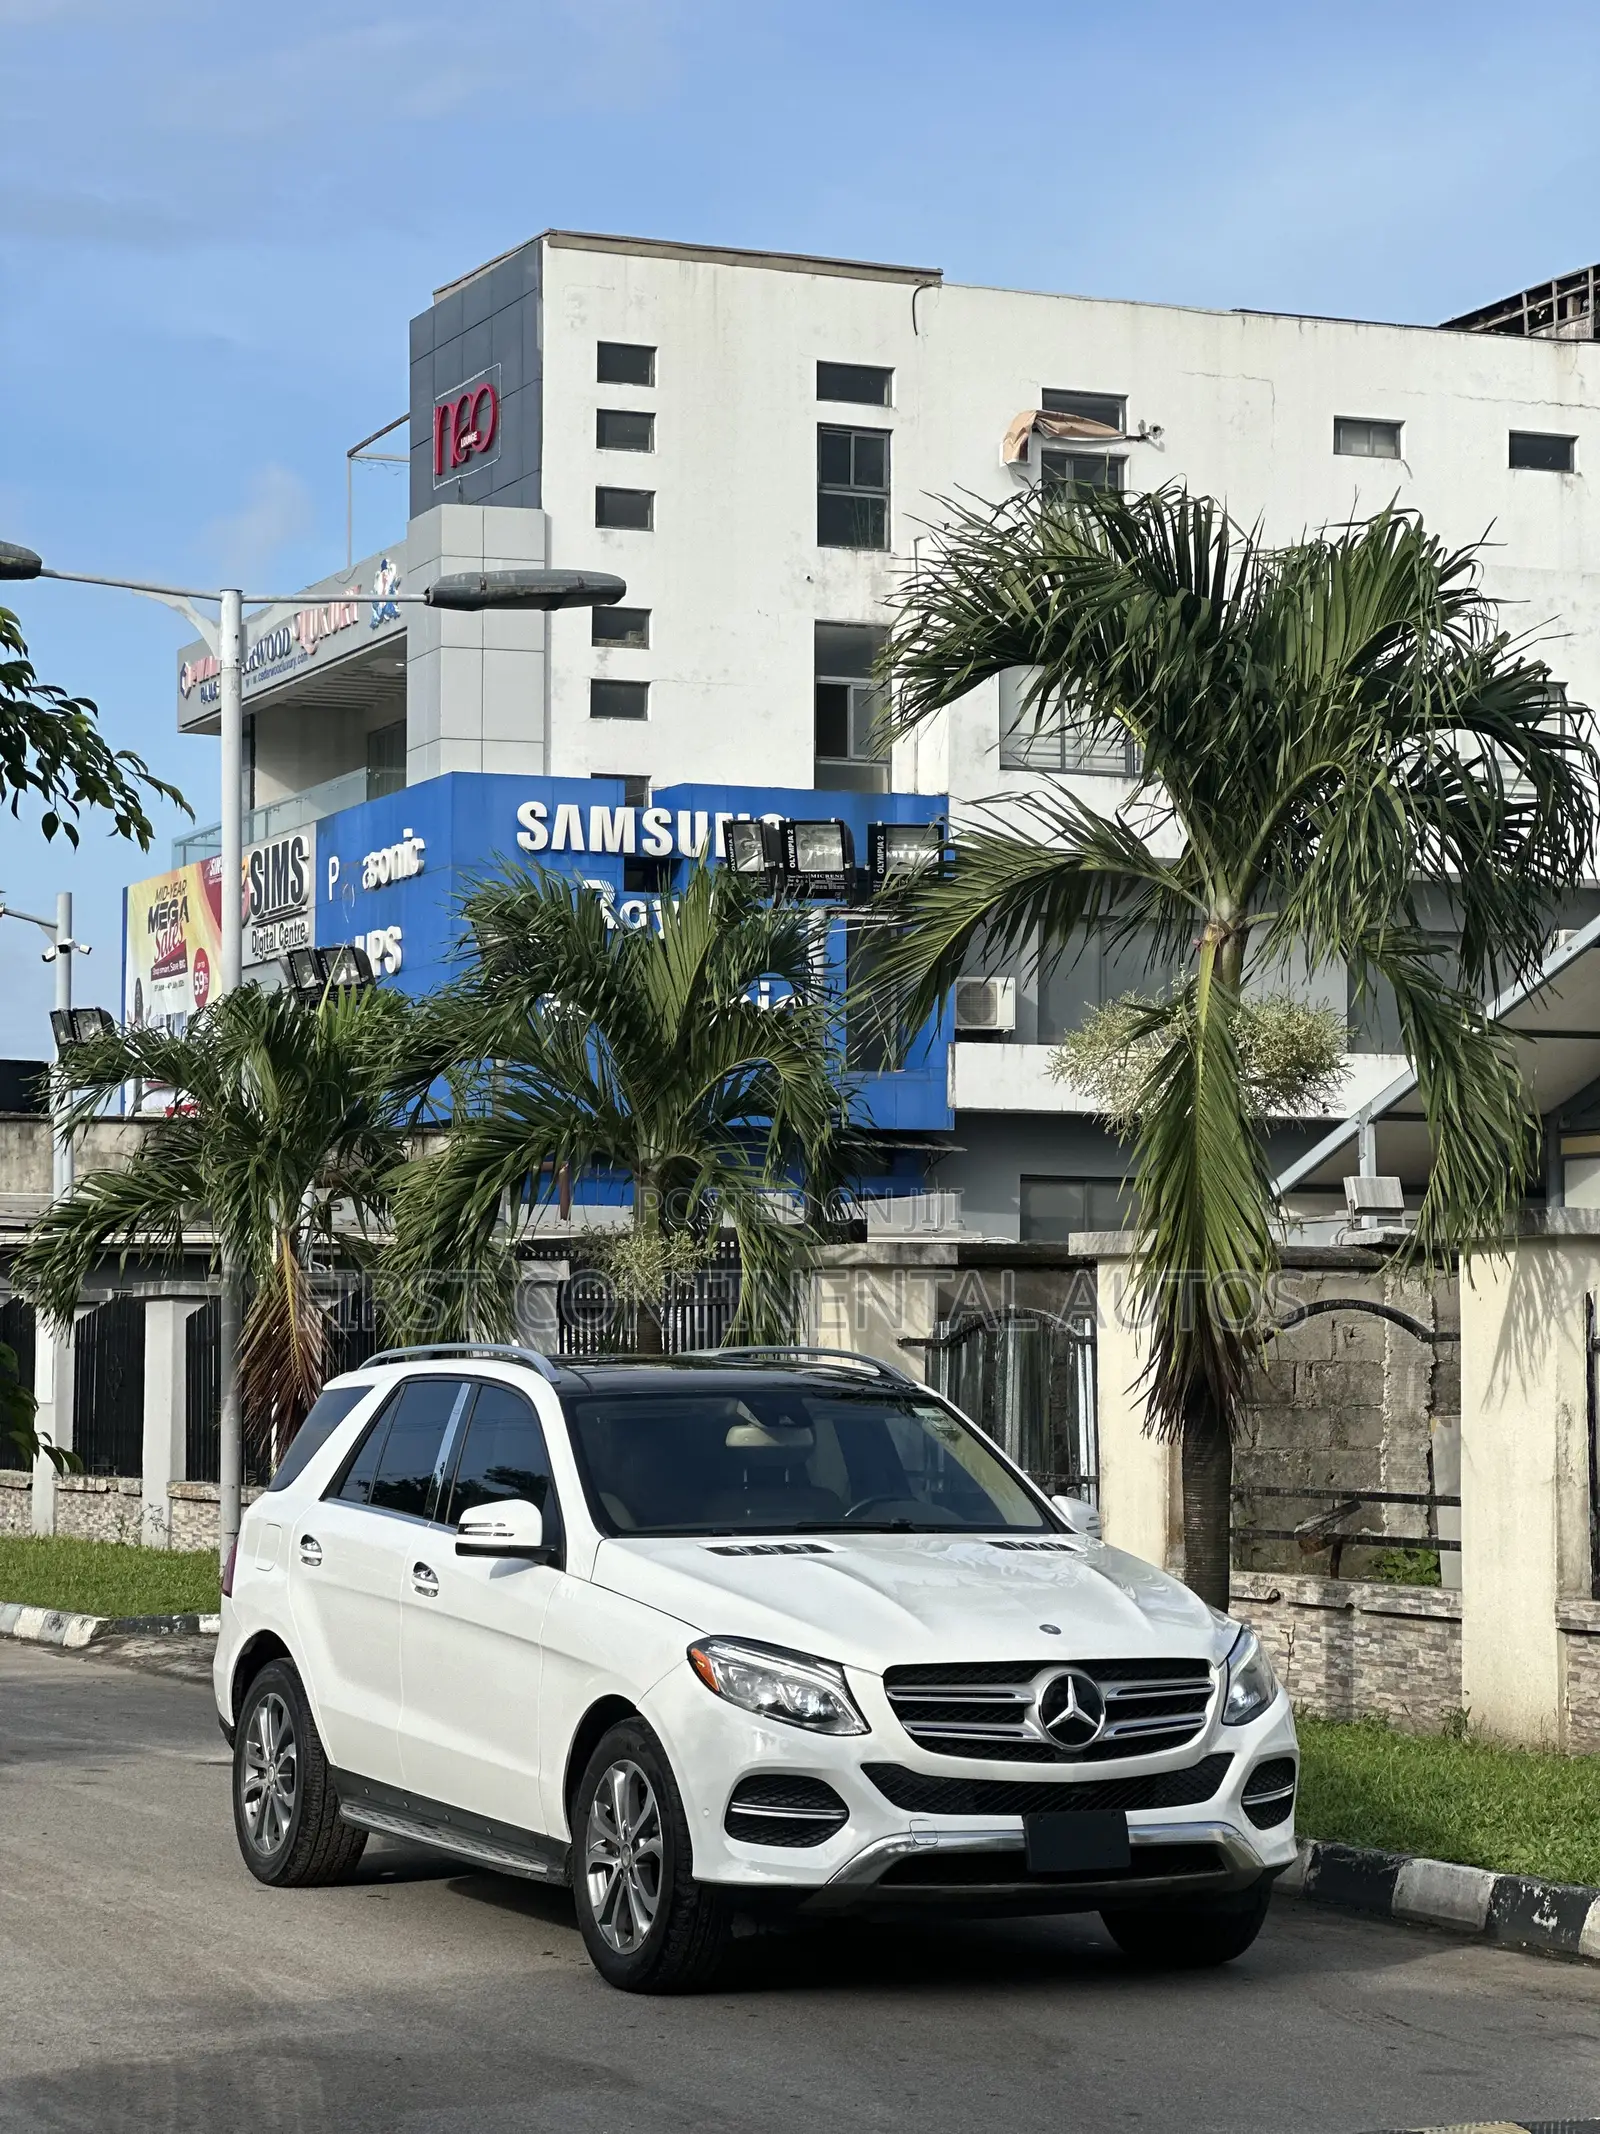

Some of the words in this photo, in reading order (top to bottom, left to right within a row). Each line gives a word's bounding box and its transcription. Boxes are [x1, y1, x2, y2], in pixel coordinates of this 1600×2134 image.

[787, 835, 796, 868] OLYMPIA
[877, 842, 885, 874] OLYMPIA
[155, 879, 187, 903] MID-YEAR
[250, 836, 310, 919] SIMS
[147, 895, 190, 934] MEGA
[154, 919, 184, 964] Sales
[251, 924, 277, 960] Digital
[278, 919, 309, 949] Centre
